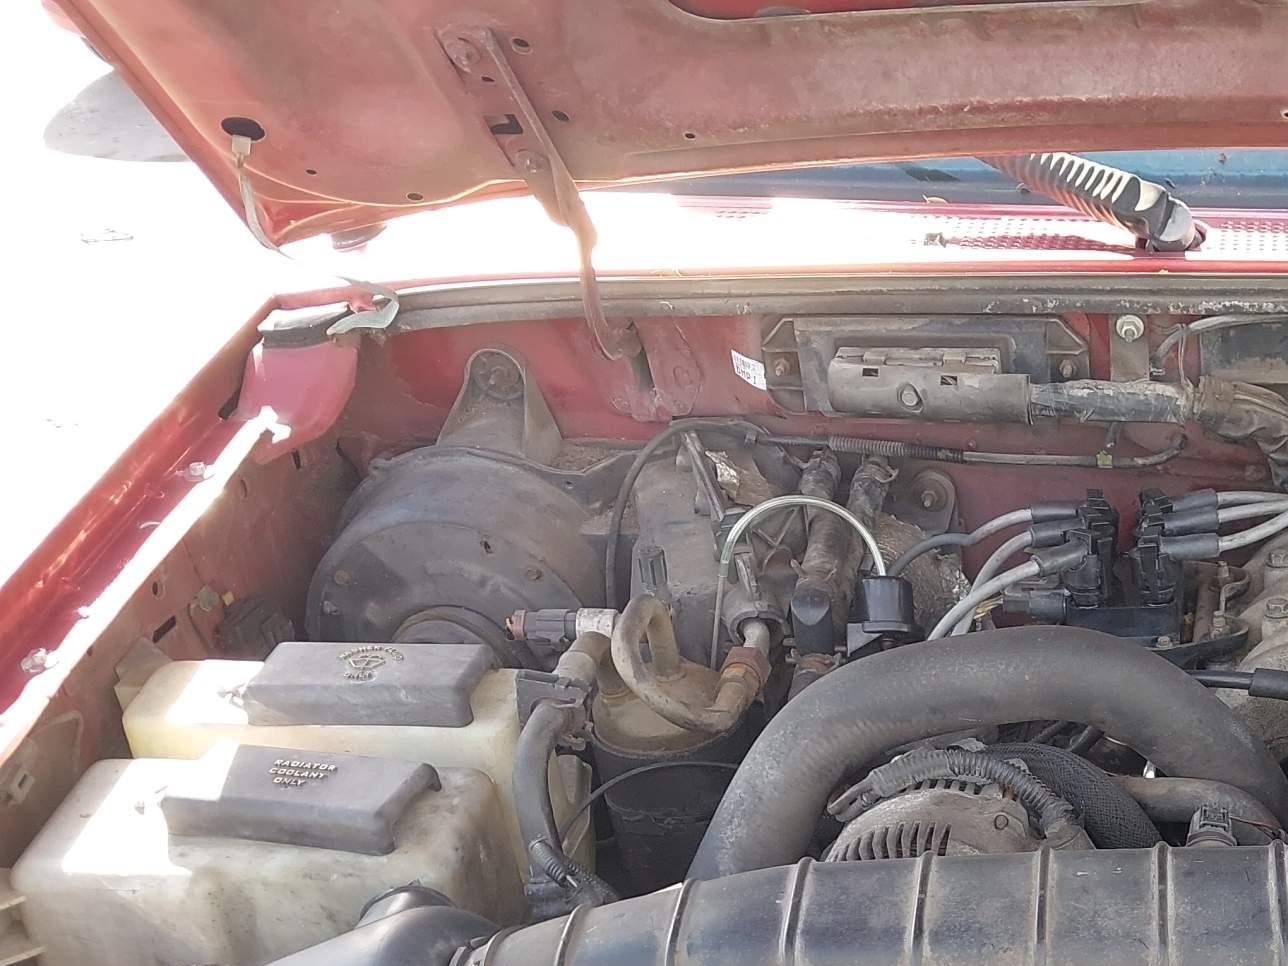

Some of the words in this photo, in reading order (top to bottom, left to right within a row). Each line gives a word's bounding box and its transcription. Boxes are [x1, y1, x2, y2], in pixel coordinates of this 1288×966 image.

[273, 759, 338, 771] RADIATOR
[268, 767, 327, 779] COOLANT
[272, 777, 306, 786] ONLY
